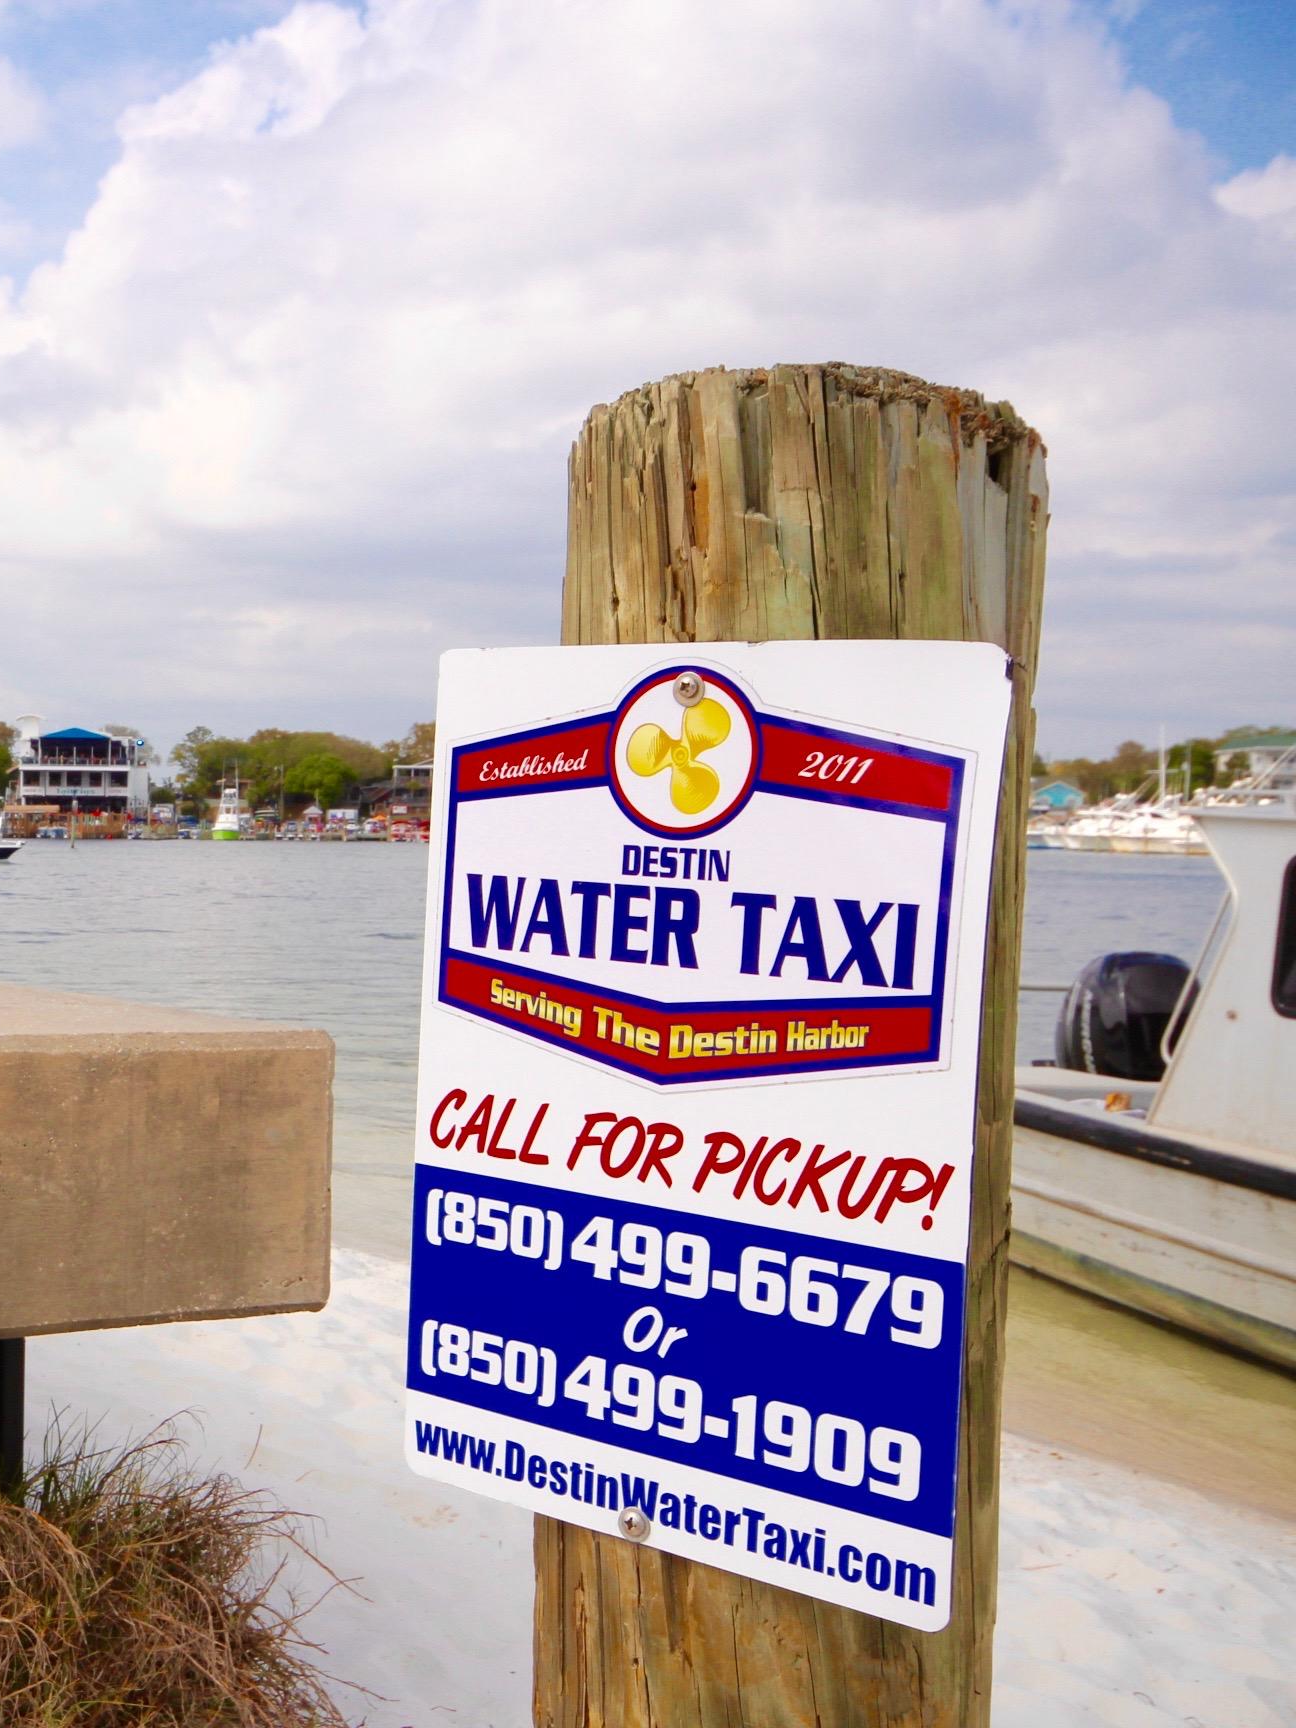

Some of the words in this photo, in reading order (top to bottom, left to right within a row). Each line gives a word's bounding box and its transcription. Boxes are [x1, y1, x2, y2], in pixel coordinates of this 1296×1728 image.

[479, 749, 589, 782] Established
[798, 752, 873, 784] 2011
[622, 845, 730, 881] DESTIN
[467, 874, 700, 969] WATER
[731, 892, 919, 990] TAXI
[490, 978, 582, 1038] Serving
[592, 1005, 660, 1056] The
[668, 1023, 777, 1059] Destin
[786, 1020, 870, 1052] Harbor
[430, 1089, 549, 1165] CALL
[567, 1112, 684, 1188] FOR
[692, 1132, 955, 1231] PICKUP!
[623, 1306, 688, 1358] Or
[415, 1420, 937, 1607] www.DestinWaterTaxi.com
